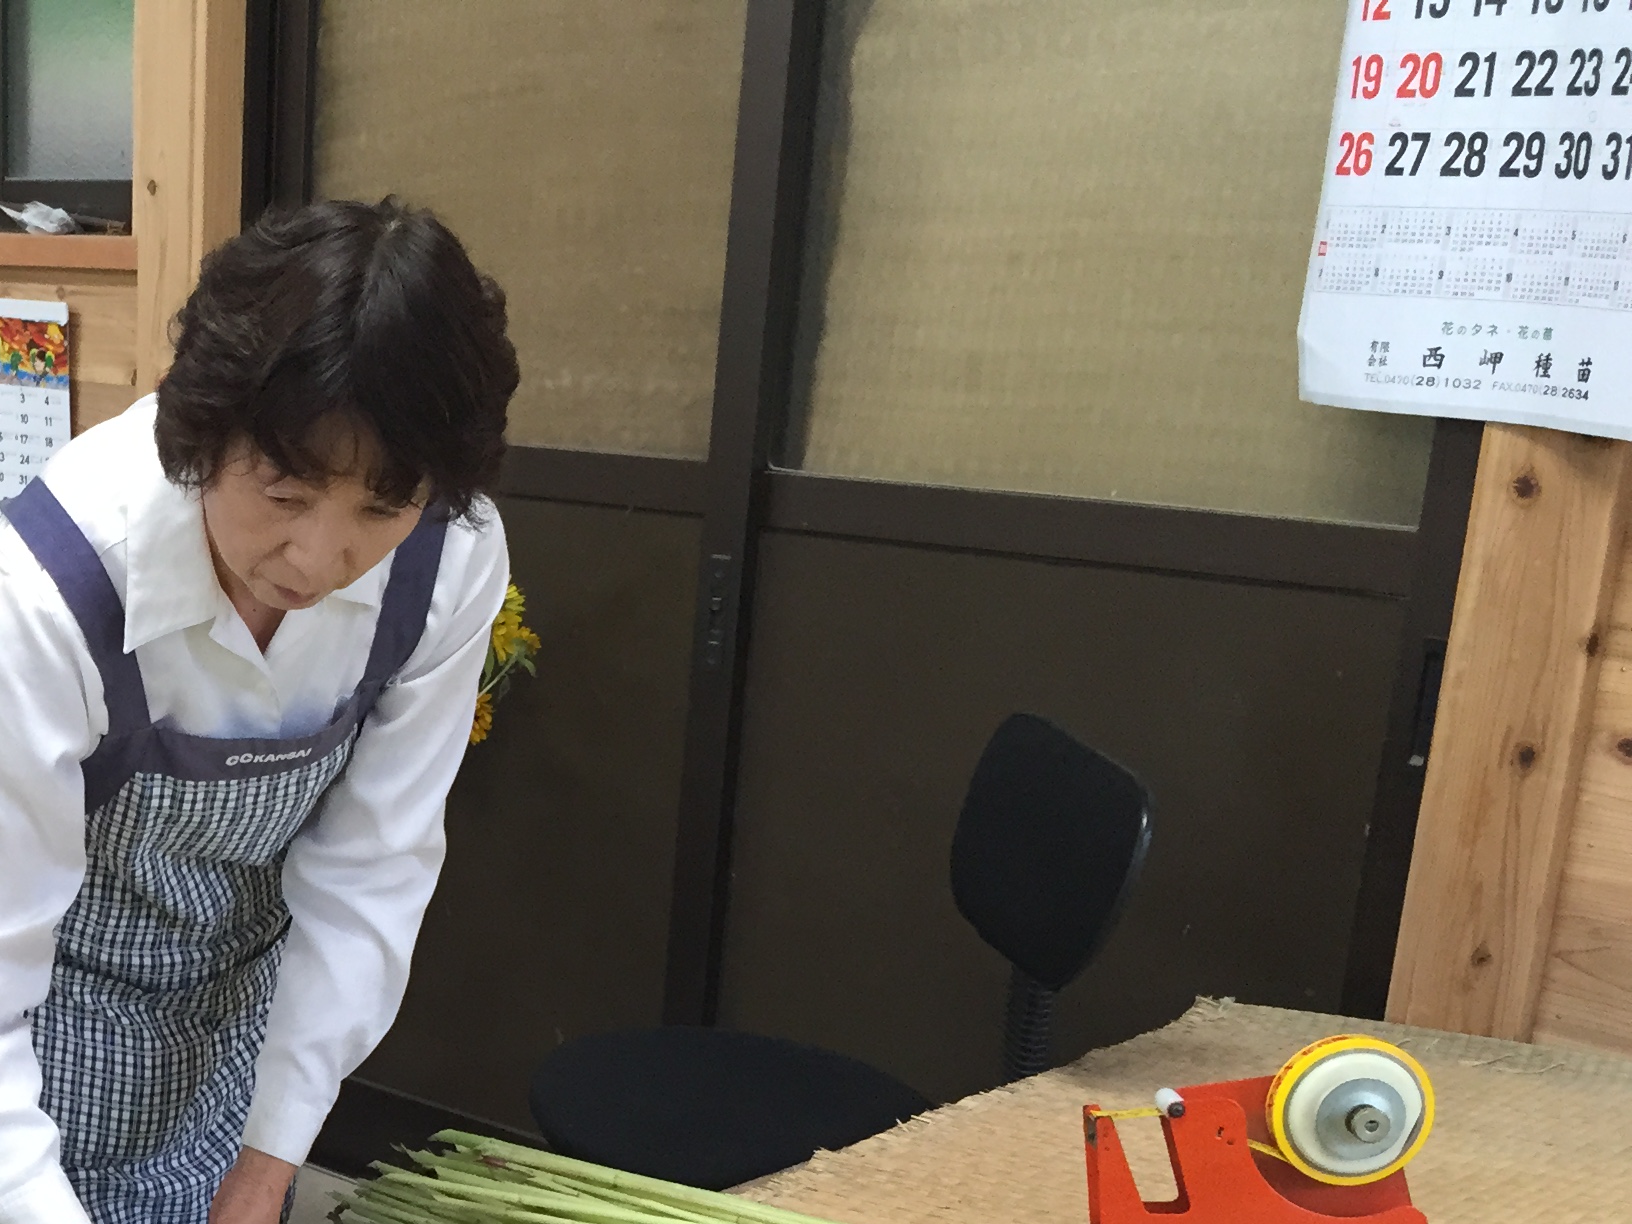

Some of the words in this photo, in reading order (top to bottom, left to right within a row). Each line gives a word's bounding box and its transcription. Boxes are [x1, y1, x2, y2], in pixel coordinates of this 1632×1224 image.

[1351, 54, 1384, 99] 19
[1396, 52, 1443, 98] 20
[1454, 52, 1496, 97] 21
[1511, 49, 1558, 97] 22
[1566, 48, 1603, 96] 23
[1611, 47, 1632, 96] 2
[1335, 132, 1374, 176] 26
[1385, 132, 1431, 176] 27
[1440, 131, 1488, 177] 28
[1499, 131, 1546, 178] 29
[1555, 131, 1592, 179] 30
[1602, 132, 1632, 180] 31
